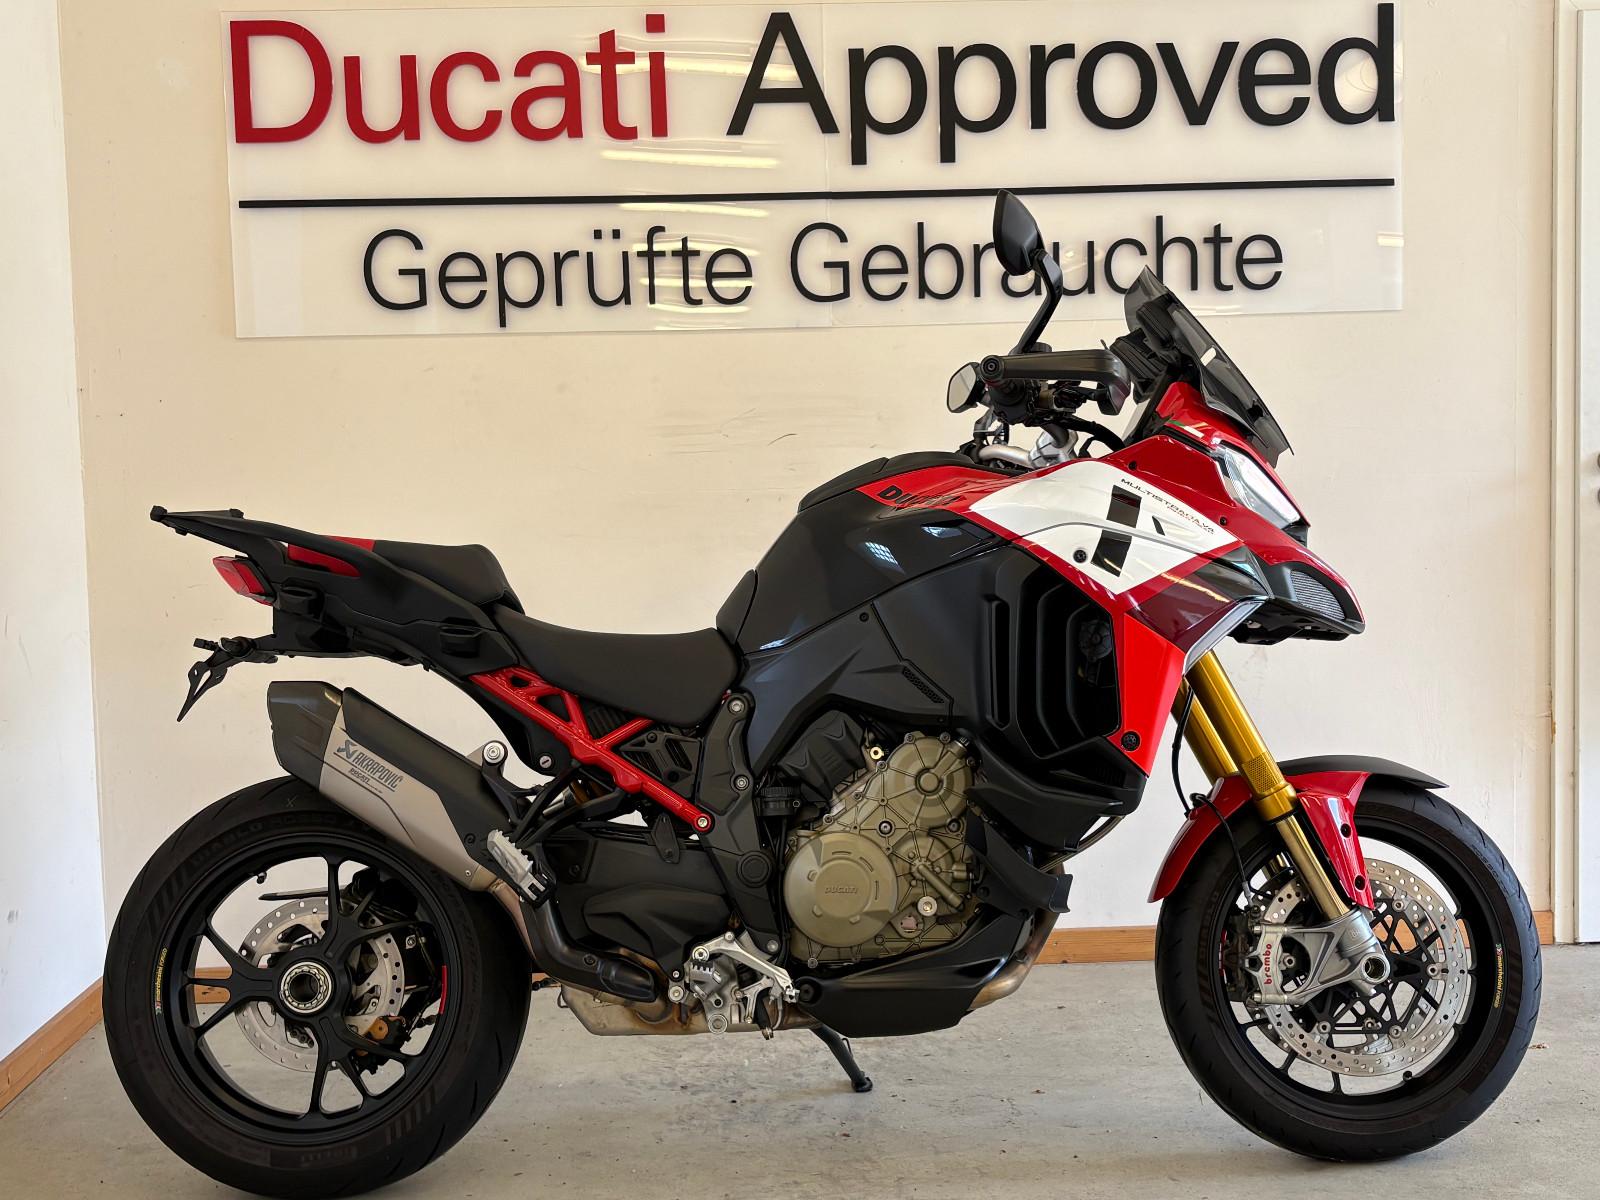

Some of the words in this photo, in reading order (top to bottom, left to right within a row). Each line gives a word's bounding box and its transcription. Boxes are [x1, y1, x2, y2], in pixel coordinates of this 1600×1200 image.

[229, 13, 668, 144] Ducati
[726, 3, 1395, 165] Approved
[363, 225, 753, 328] Geprüfte
[1263, 943, 1273, 985] brembo
